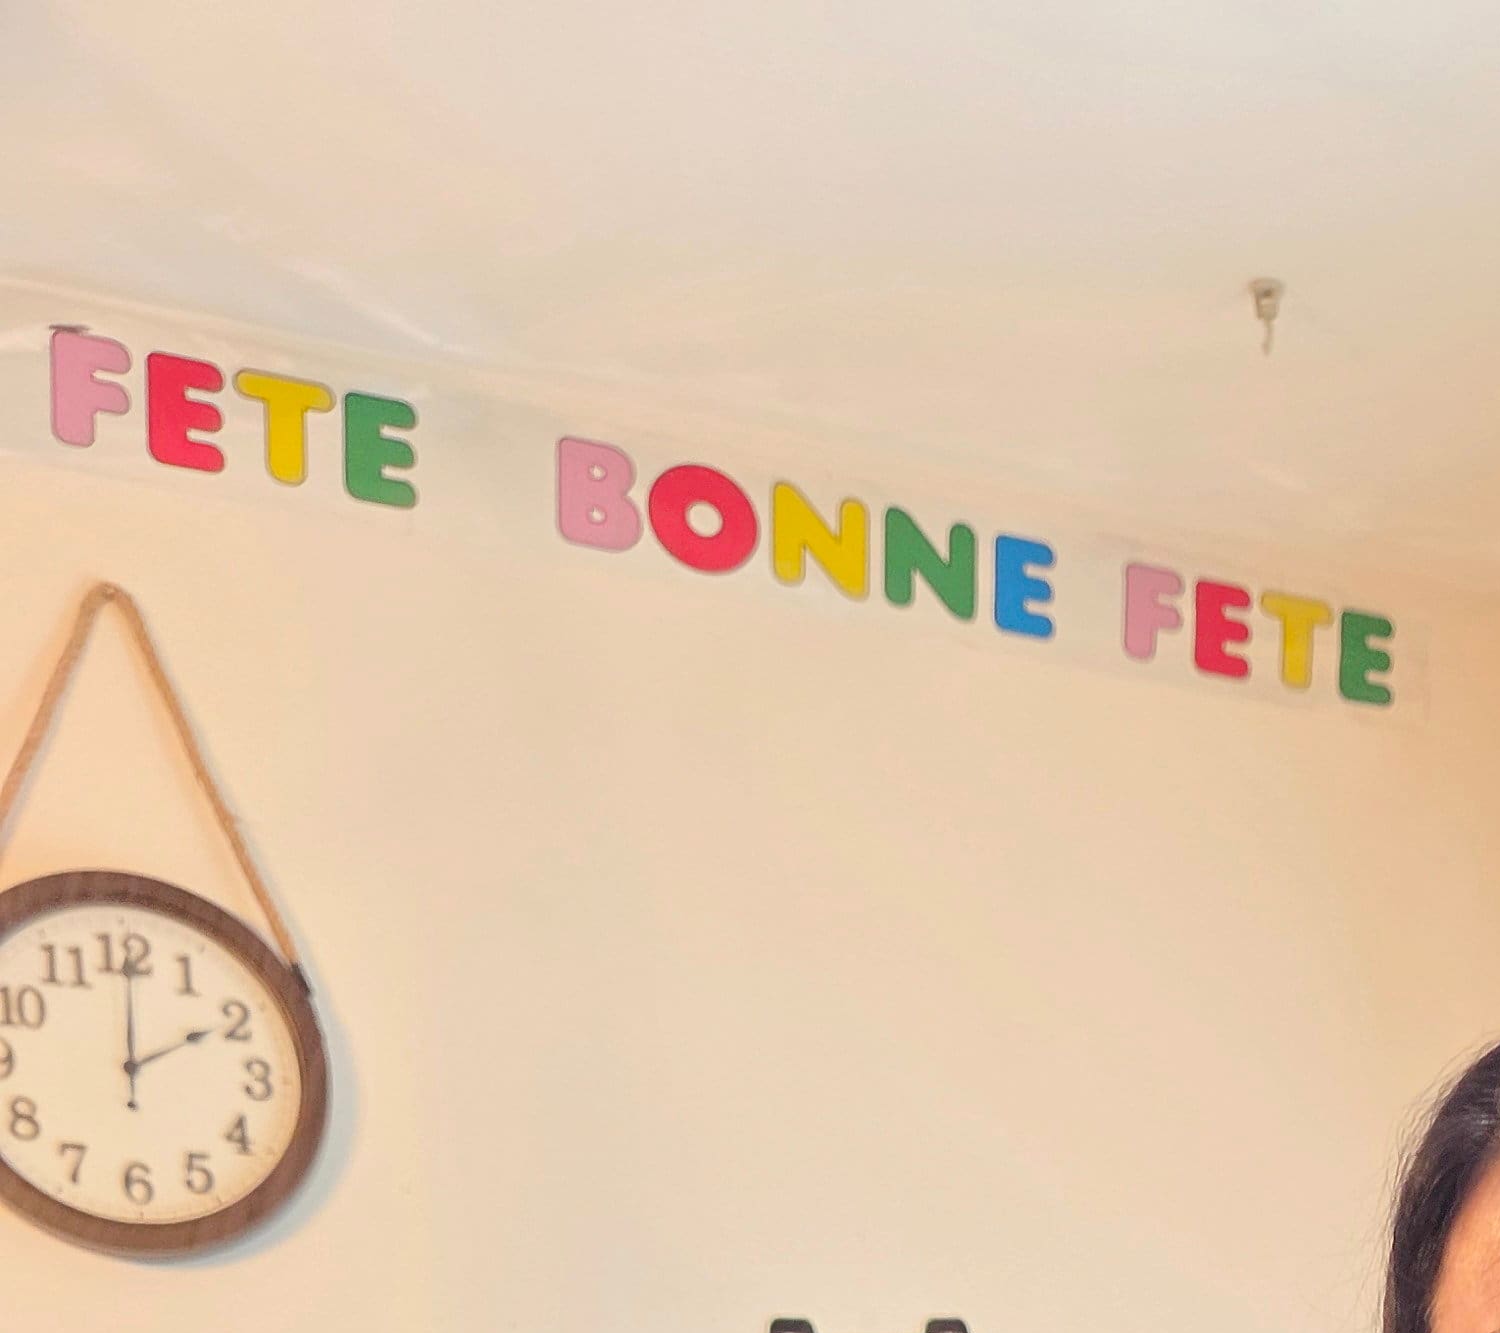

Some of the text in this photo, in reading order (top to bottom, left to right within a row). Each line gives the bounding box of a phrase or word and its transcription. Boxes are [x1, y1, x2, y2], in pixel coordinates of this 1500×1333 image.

[50, 330, 418, 509] FETE
[555, 436, 1394, 706] BONNE FETE
[40, 942, 92, 988] 11
[96, 932, 154, 977] 12
[175, 952, 200, 997] 1
[0, 984, 46, 1030] 10
[220, 999, 253, 1042] 2
[243, 1056, 274, 1102] 3
[9, 1096, 41, 1142] 8
[225, 1112, 253, 1156] 4
[58, 1142, 88, 1185] 7
[122, 1160, 155, 1206] 6
[183, 1151, 215, 1196] 5
